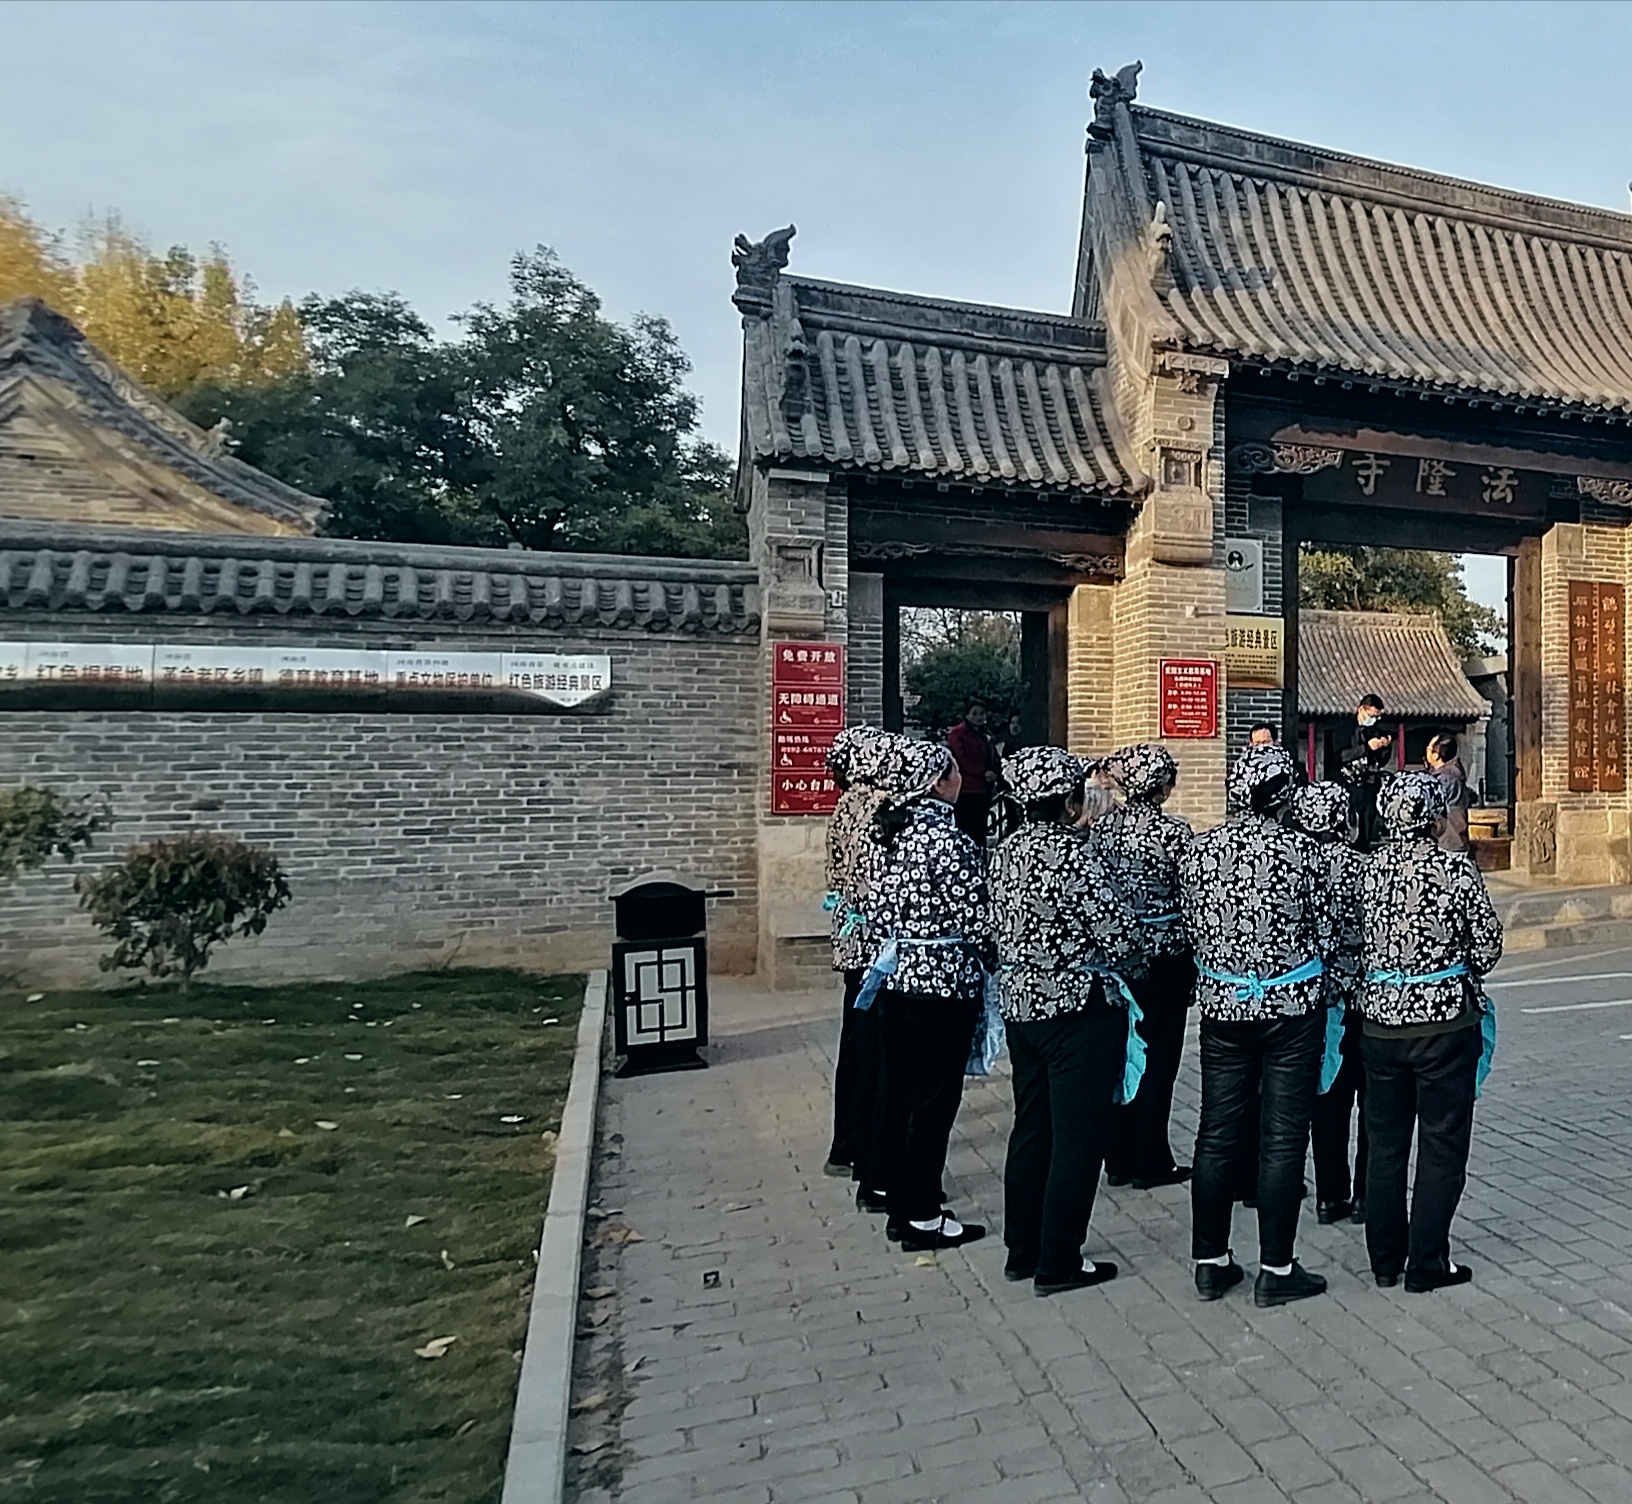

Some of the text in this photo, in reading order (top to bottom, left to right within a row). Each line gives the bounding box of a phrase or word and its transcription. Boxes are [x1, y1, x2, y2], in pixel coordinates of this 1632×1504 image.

[1352, 453, 1519, 504] 法隆寺
[783, 649, 836, 663] 免费开放
[509, 673, 602, 690] 红色旅游经典景区
[778, 693, 839, 706] 无障碍通道
[782, 779, 835, 792] 小心台阶
